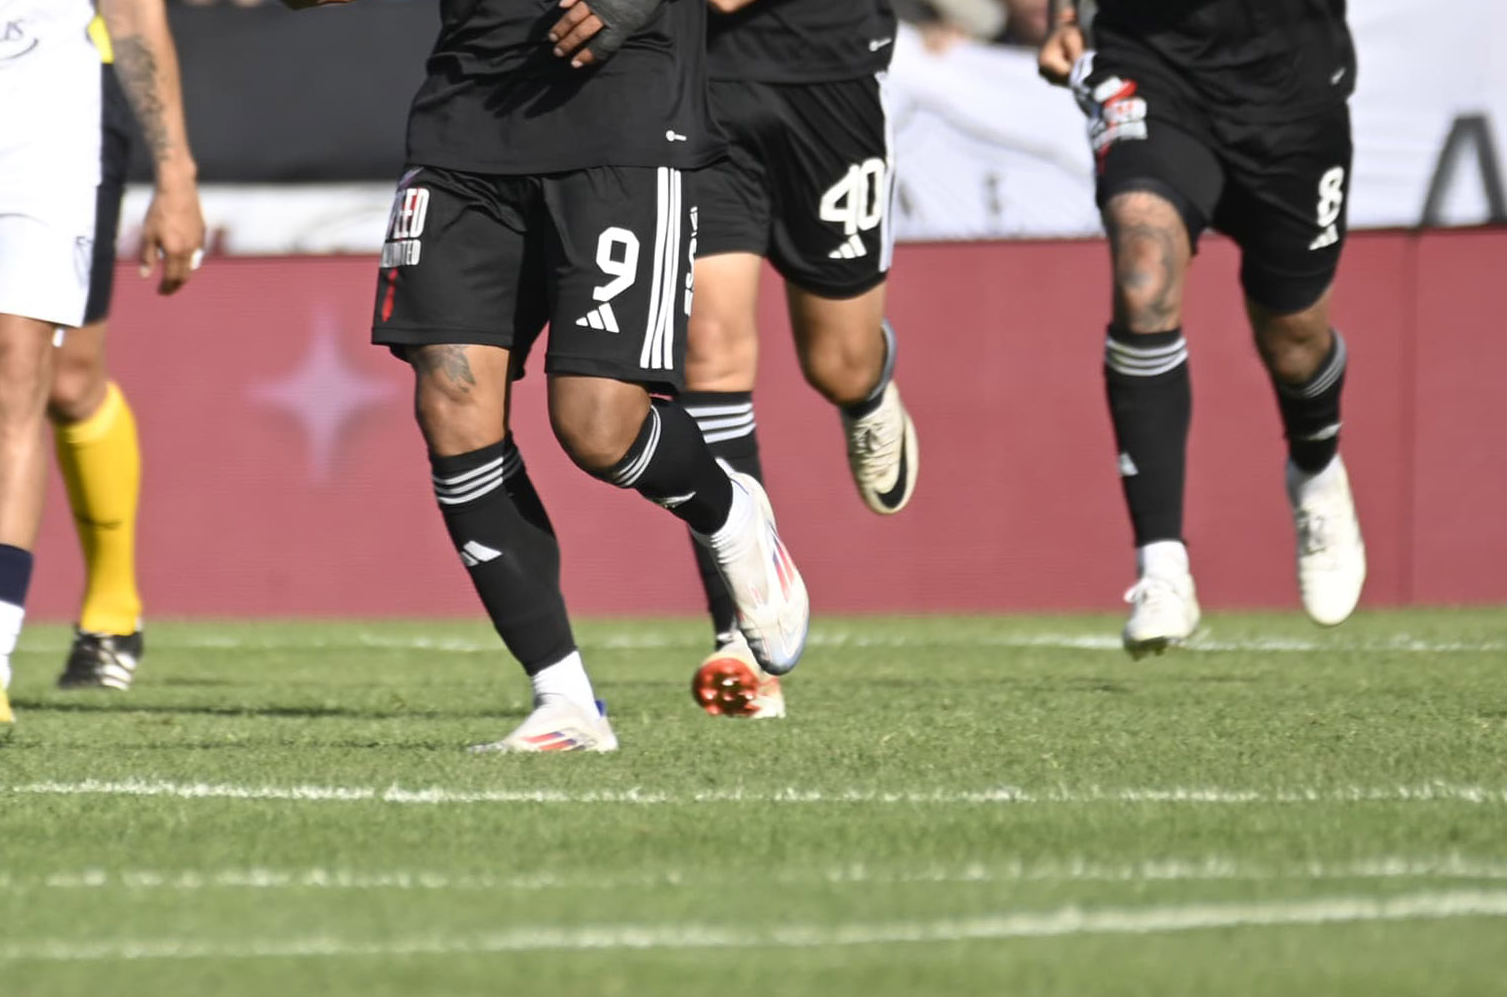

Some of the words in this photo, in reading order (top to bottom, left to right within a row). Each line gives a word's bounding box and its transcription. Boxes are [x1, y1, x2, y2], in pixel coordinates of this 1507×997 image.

[820, 158, 885, 235] 40
[1317, 166, 1344, 227] 8
[593, 227, 640, 302] 9
